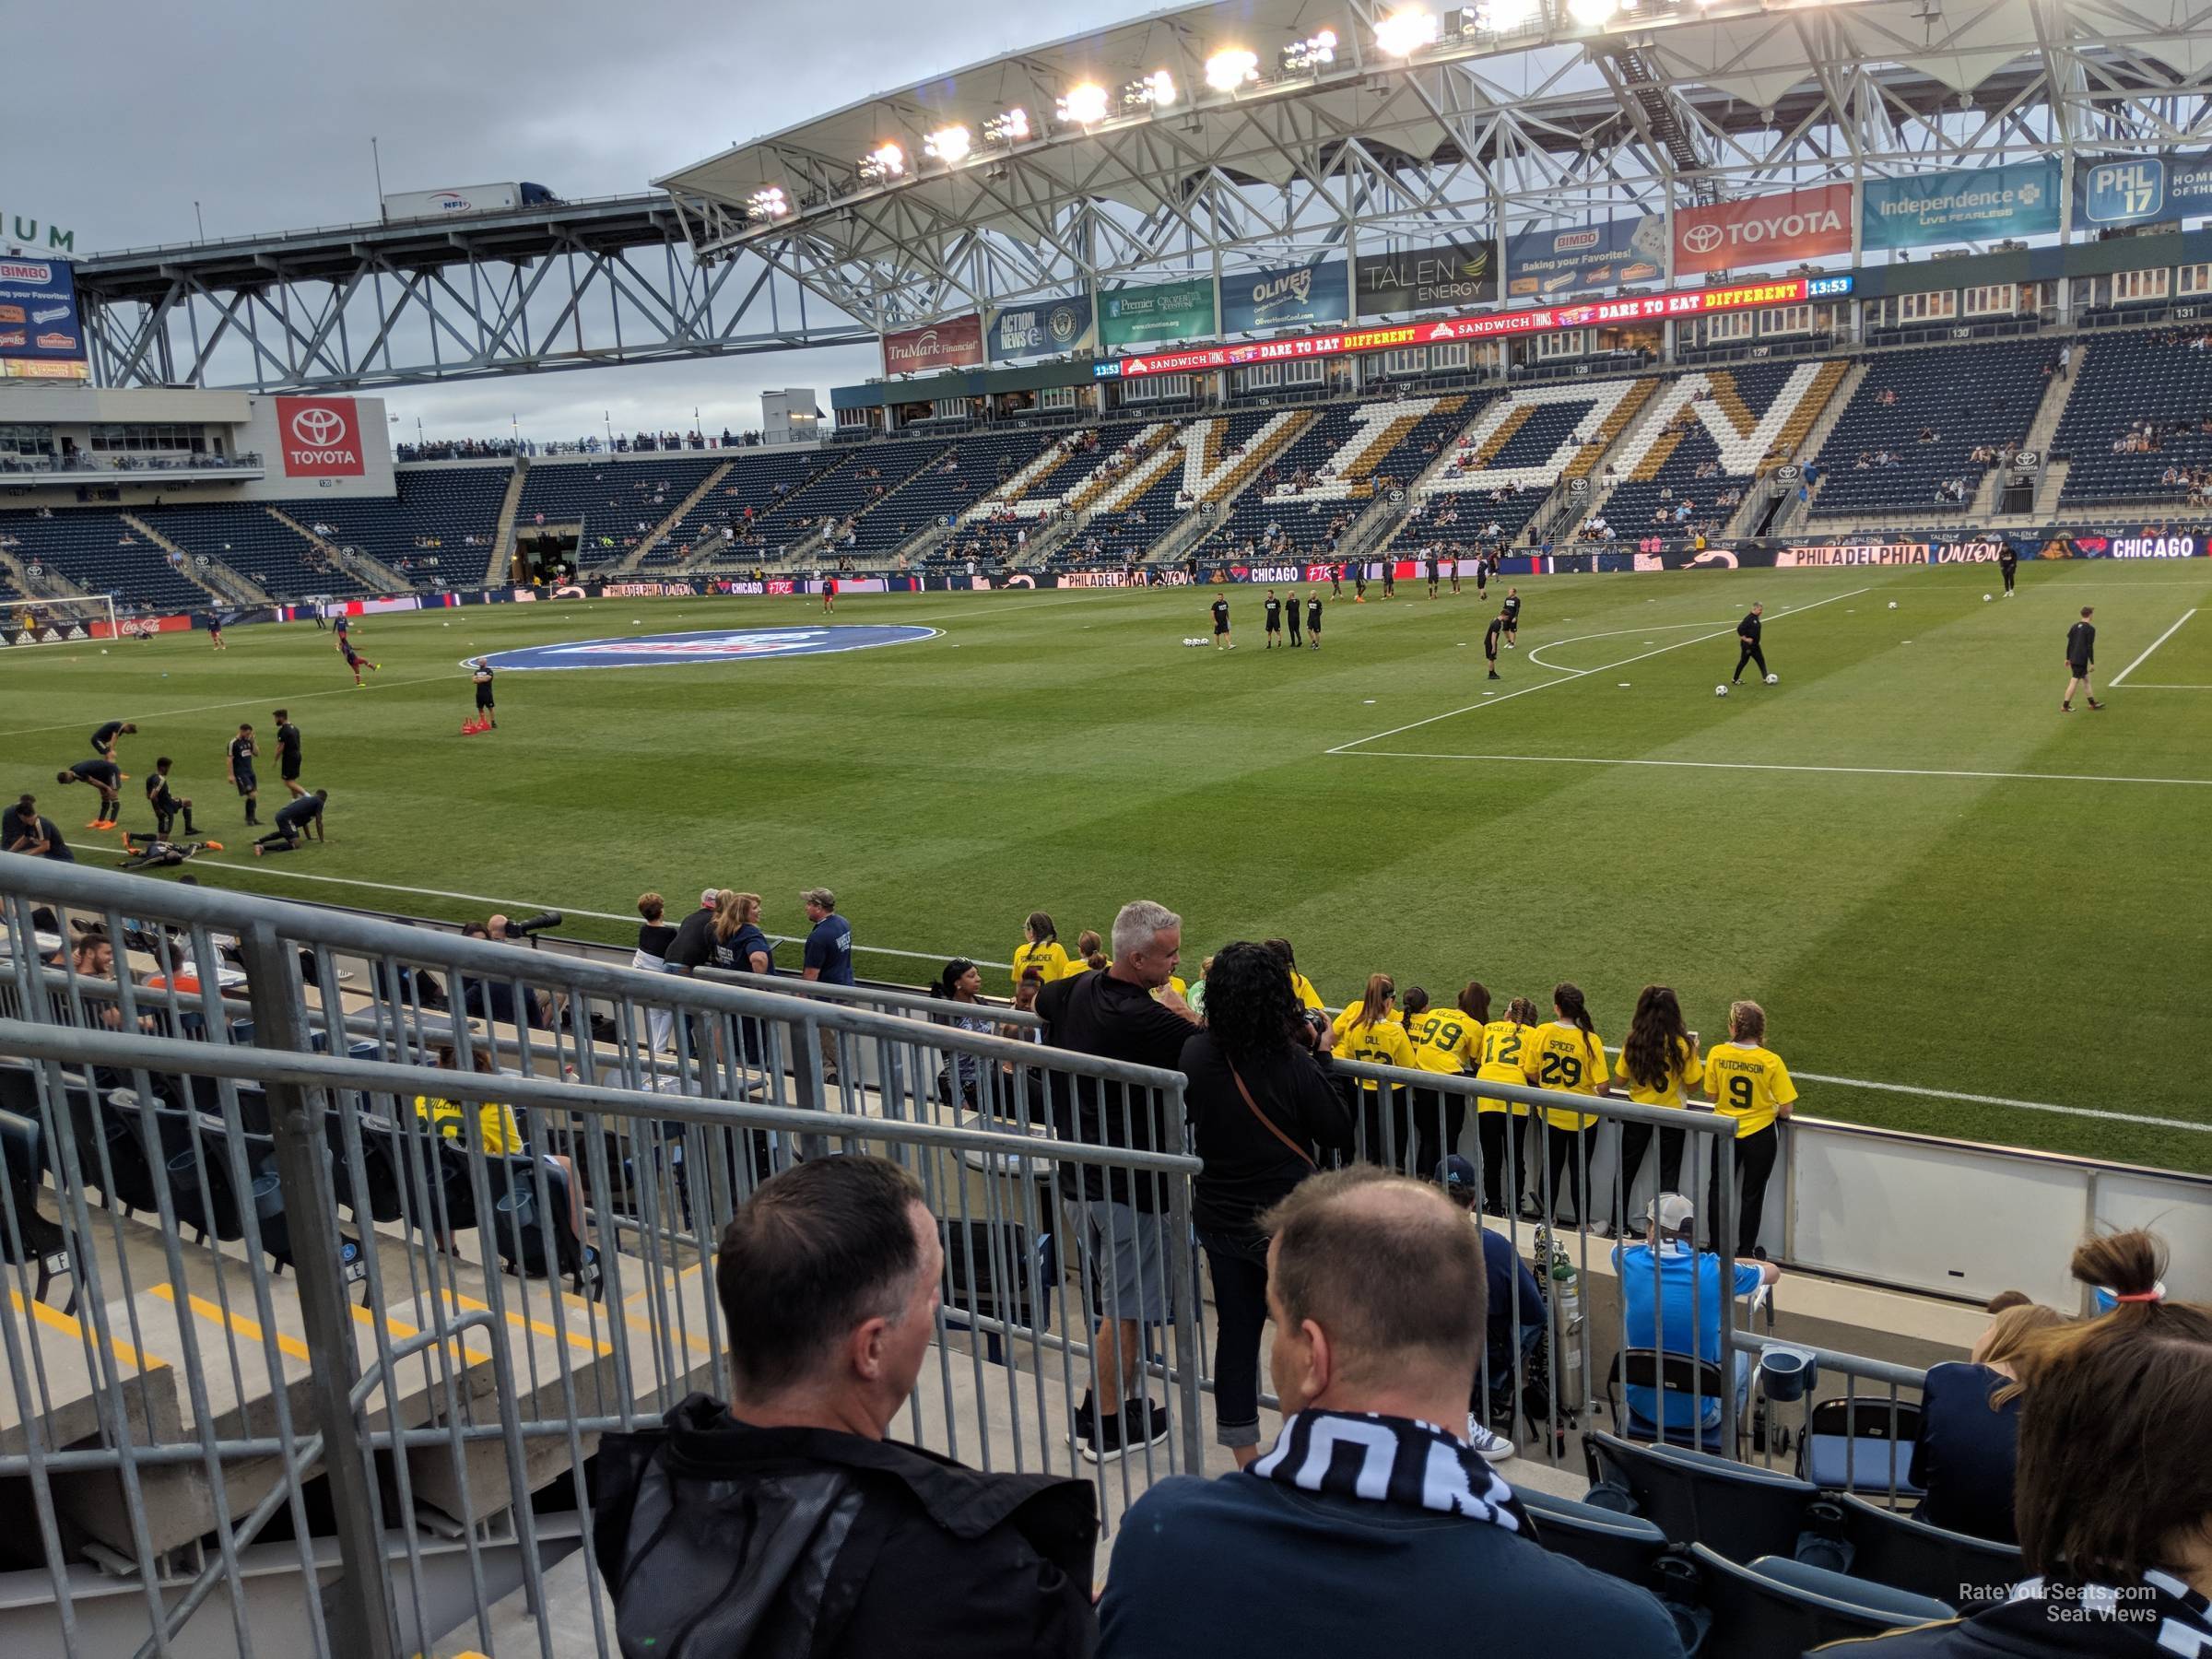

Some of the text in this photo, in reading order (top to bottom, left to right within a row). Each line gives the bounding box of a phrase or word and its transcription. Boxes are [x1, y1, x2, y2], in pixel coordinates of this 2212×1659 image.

[2096, 165, 2153, 194] PHL
[2172, 187, 2189, 197] OF
[1881, 189, 2014, 217] Independence
[2124, 188, 2153, 215] 17
[1920, 208, 2013, 226] LIVE FEARLESS
[1726, 209, 1841, 245] TOYOTA
[1558, 233, 1596, 247] BIMBO
[1523, 249, 1631, 273] Baking your Favorites!
[1, 265, 48, 279] BIMBO
[1364, 257, 1455, 291] TALEN
[1253, 269, 1312, 302] OLIVER
[1418, 281, 1482, 301] ENERGY
[1810, 277, 1848, 296] 13:53
[1121, 299, 1153, 311] Premier
[1599, 284, 1797, 319] DARE TO EAT DIFFERENT
[2176, 308, 2194, 319] 131
[1001, 312, 1036, 333] ACTION
[1458, 317, 1530, 334] SANDWICH
[1953, 327, 1970, 338] 130
[888, 340, 976, 360] TruMark Financial
[1001, 333, 1027, 350] NEWS
[1261, 328, 1416, 358] DARE TO EAT DIFFERENT
[1096, 364, 1120, 377] 13:53
[1150, 356, 1207, 370] SANDWICH
[1574, 365, 1588, 375] 128
[1398, 382, 1412, 392] 127
[1259, 397, 1270, 406] 126
[1132, 409, 1143, 418] 125
[1018, 420, 1029, 429] 124
[912, 429, 921, 438] 123
[290, 451, 356, 464] TOYOTA
[1797, 543, 2004, 565] PHILADELPHIA UNION
[2112, 537, 2194, 558] CHICAGO
[1068, 571, 1147, 588] PHILADELPHA
[1252, 567, 1298, 582] CHICAGO
[610, 583, 662, 596] PHILADELPHIA
[732, 582, 793, 594] CHICAGO FIRE
[1420, 1018, 1463, 1052] 99
[1486, 1034, 1522, 1065] 12
[1550, 1040, 1575, 1053] SPICER
[1540, 1052, 1582, 1088] 29
[1718, 1059, 1764, 1075] HUTCHINSON
[1729, 1076, 1753, 1110] 9
